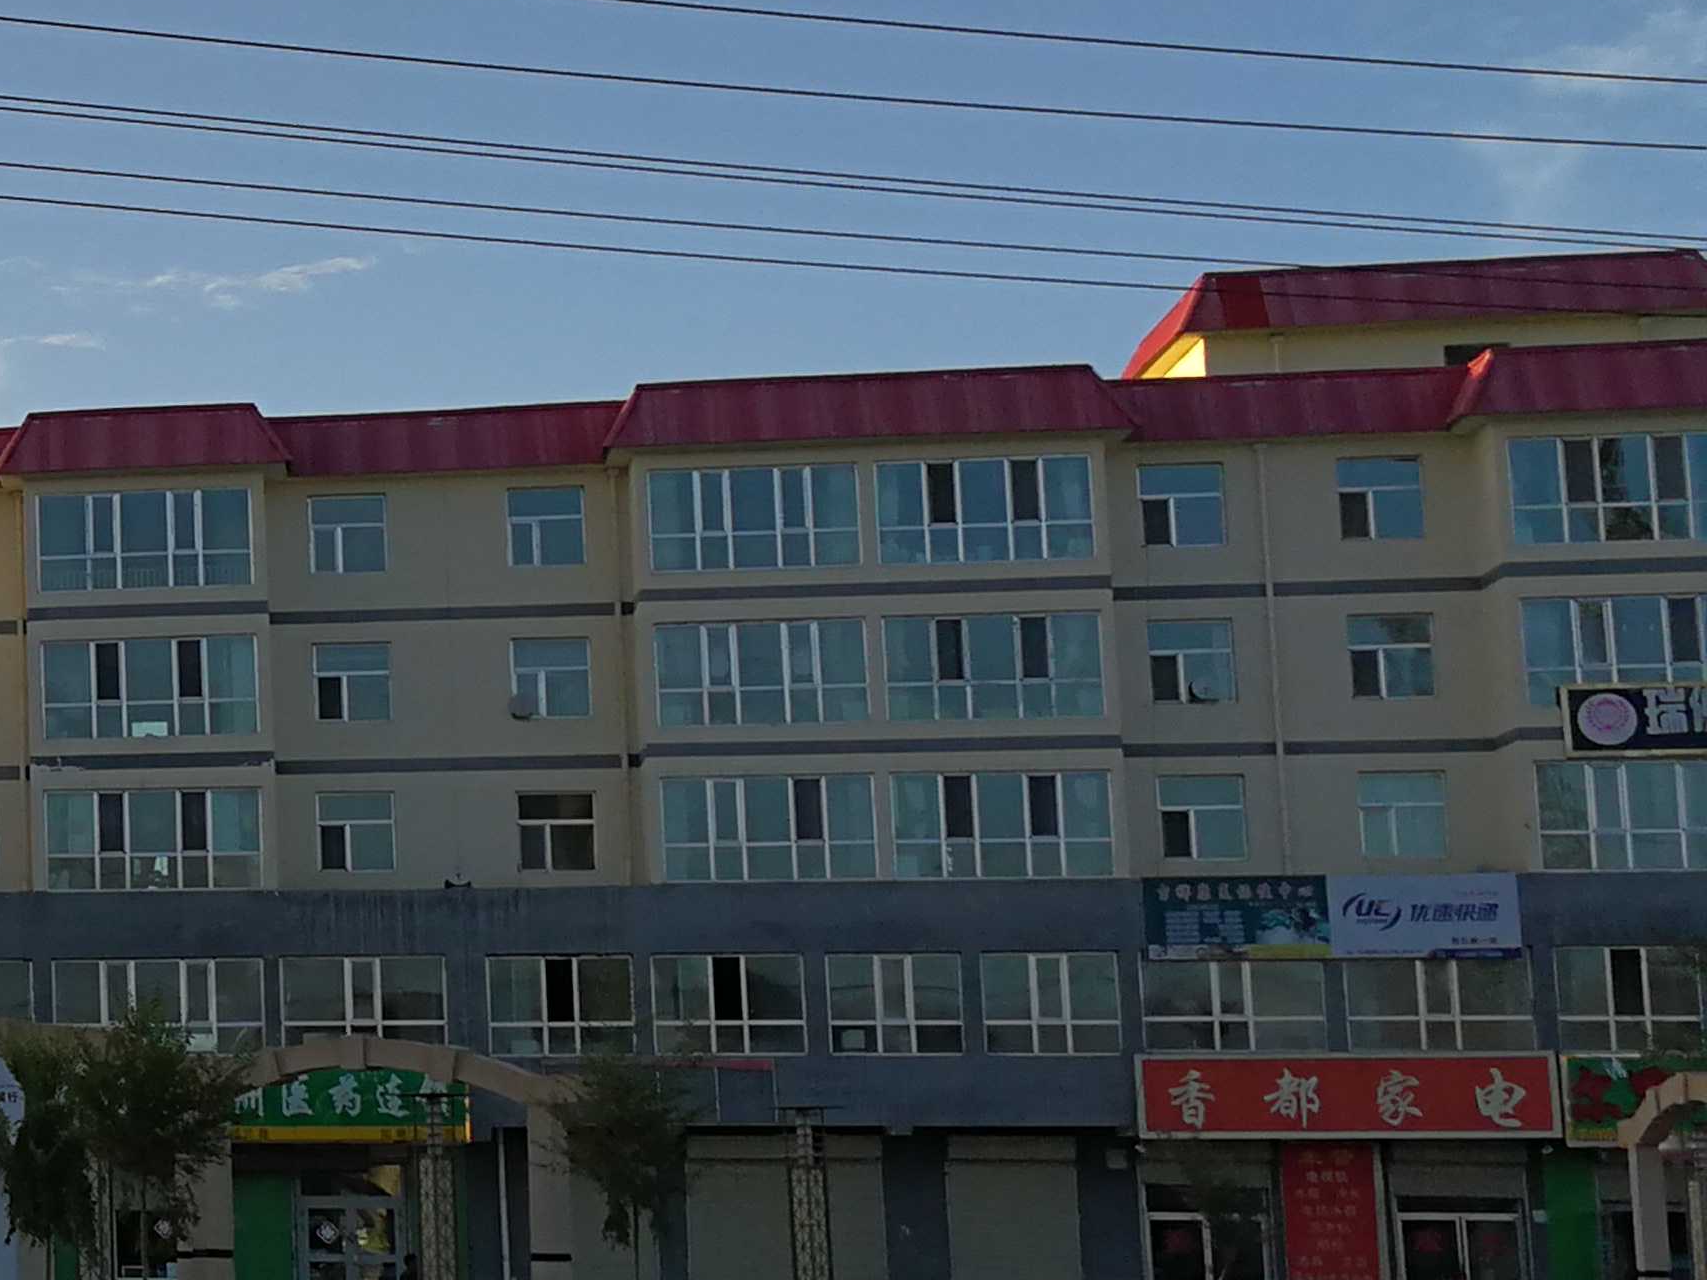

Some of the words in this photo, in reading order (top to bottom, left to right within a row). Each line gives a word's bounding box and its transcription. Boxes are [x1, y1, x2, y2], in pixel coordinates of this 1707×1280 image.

[1410, 903, 1499, 922] 优速快递
[1166, 1066, 1529, 1129] 香都家电
